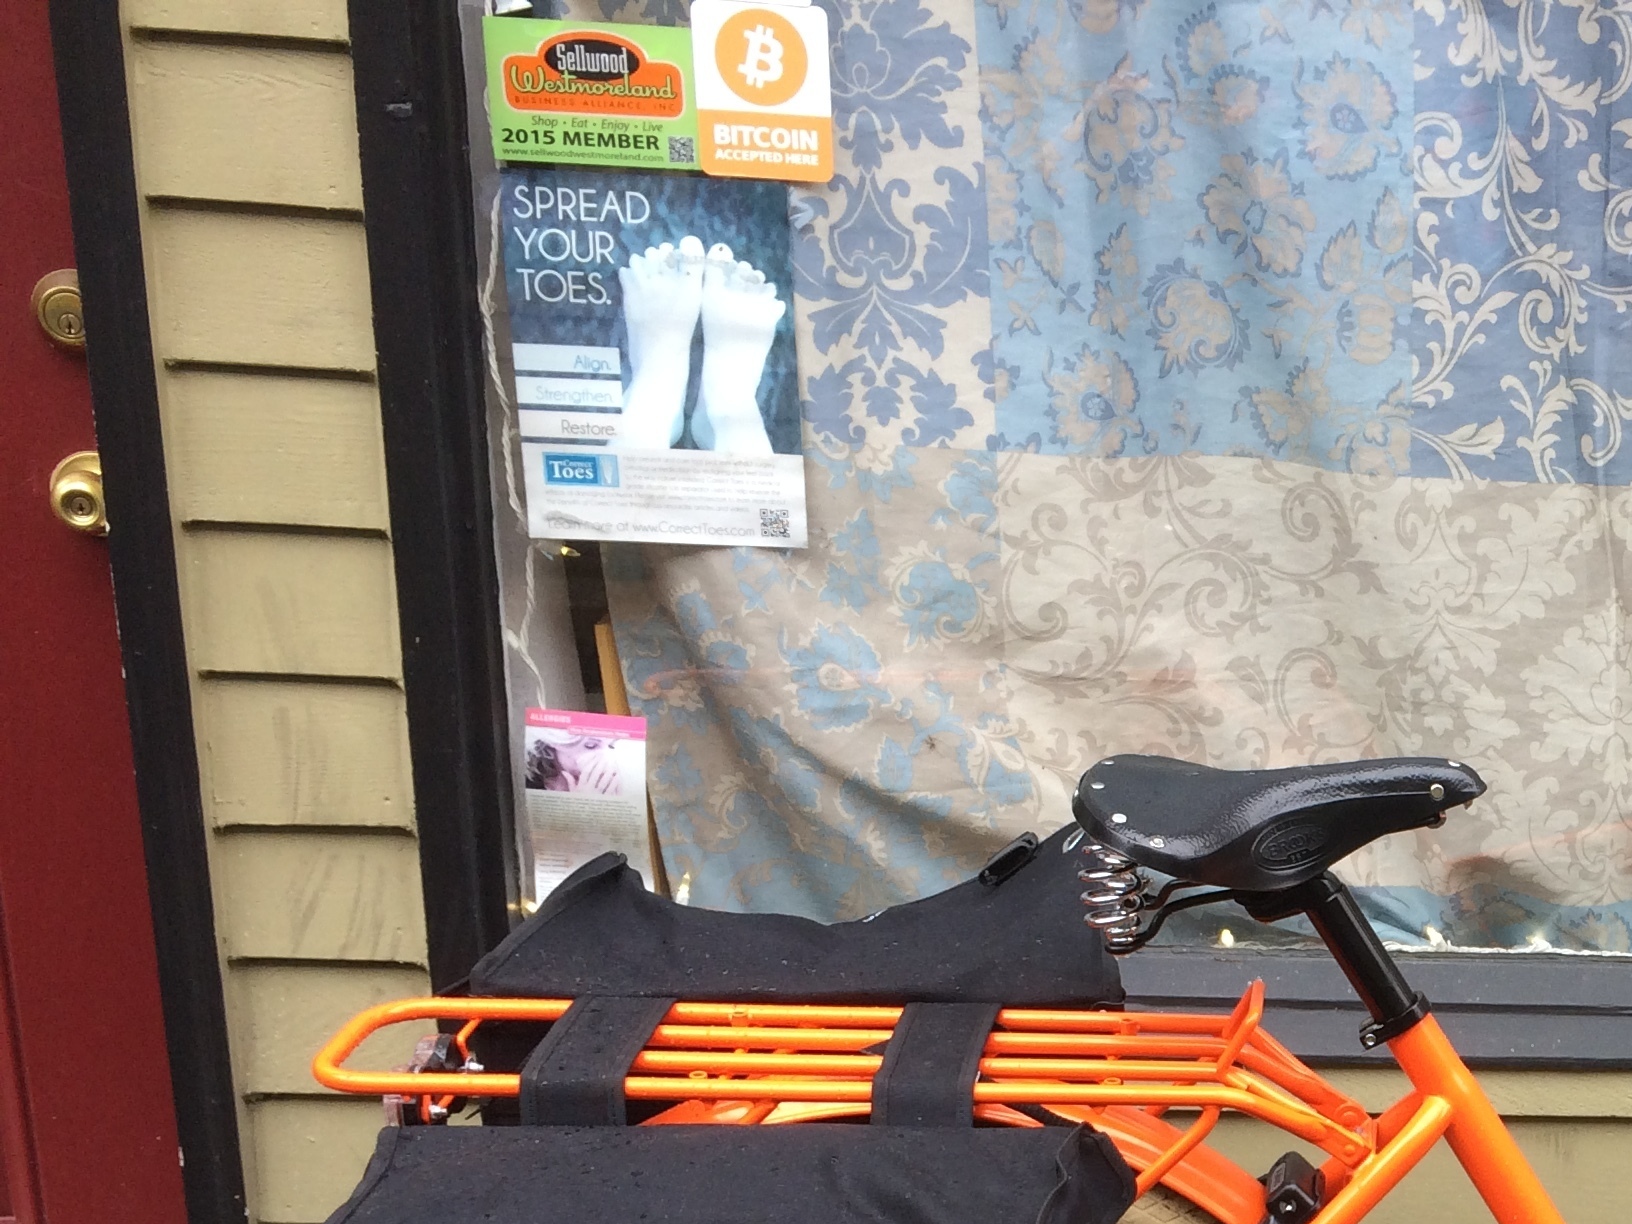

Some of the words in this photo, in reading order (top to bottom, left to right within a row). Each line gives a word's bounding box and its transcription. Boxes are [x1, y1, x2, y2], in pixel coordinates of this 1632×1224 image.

[556, 43, 629, 74] Sellwood
[510, 65, 677, 99] Westmoreland
[514, 95, 575, 108] BUSINESS
[531, 115, 559, 129] Shop
[571, 117, 588, 129] Eat
[601, 118, 630, 132] Enjoy
[642, 121, 664, 132] Live
[501, 127, 556, 146] 2015
[562, 130, 660, 151] MEMBER
[713, 122, 819, 151] BITCOIN
[501, 148, 665, 163] www.sellwoodwestmoreland.com
[714, 148, 783, 164] ACCEPTED
[784, 152, 819, 167] HERE
[513, 184, 650, 224] SPREAD
[513, 226, 615, 265] YOUR
[515, 268, 612, 306] TOES.
[560, 419, 618, 436] Restore.
[548, 459, 594, 479] Toes
[632, 520, 756, 537] www.CorrectToes.com
